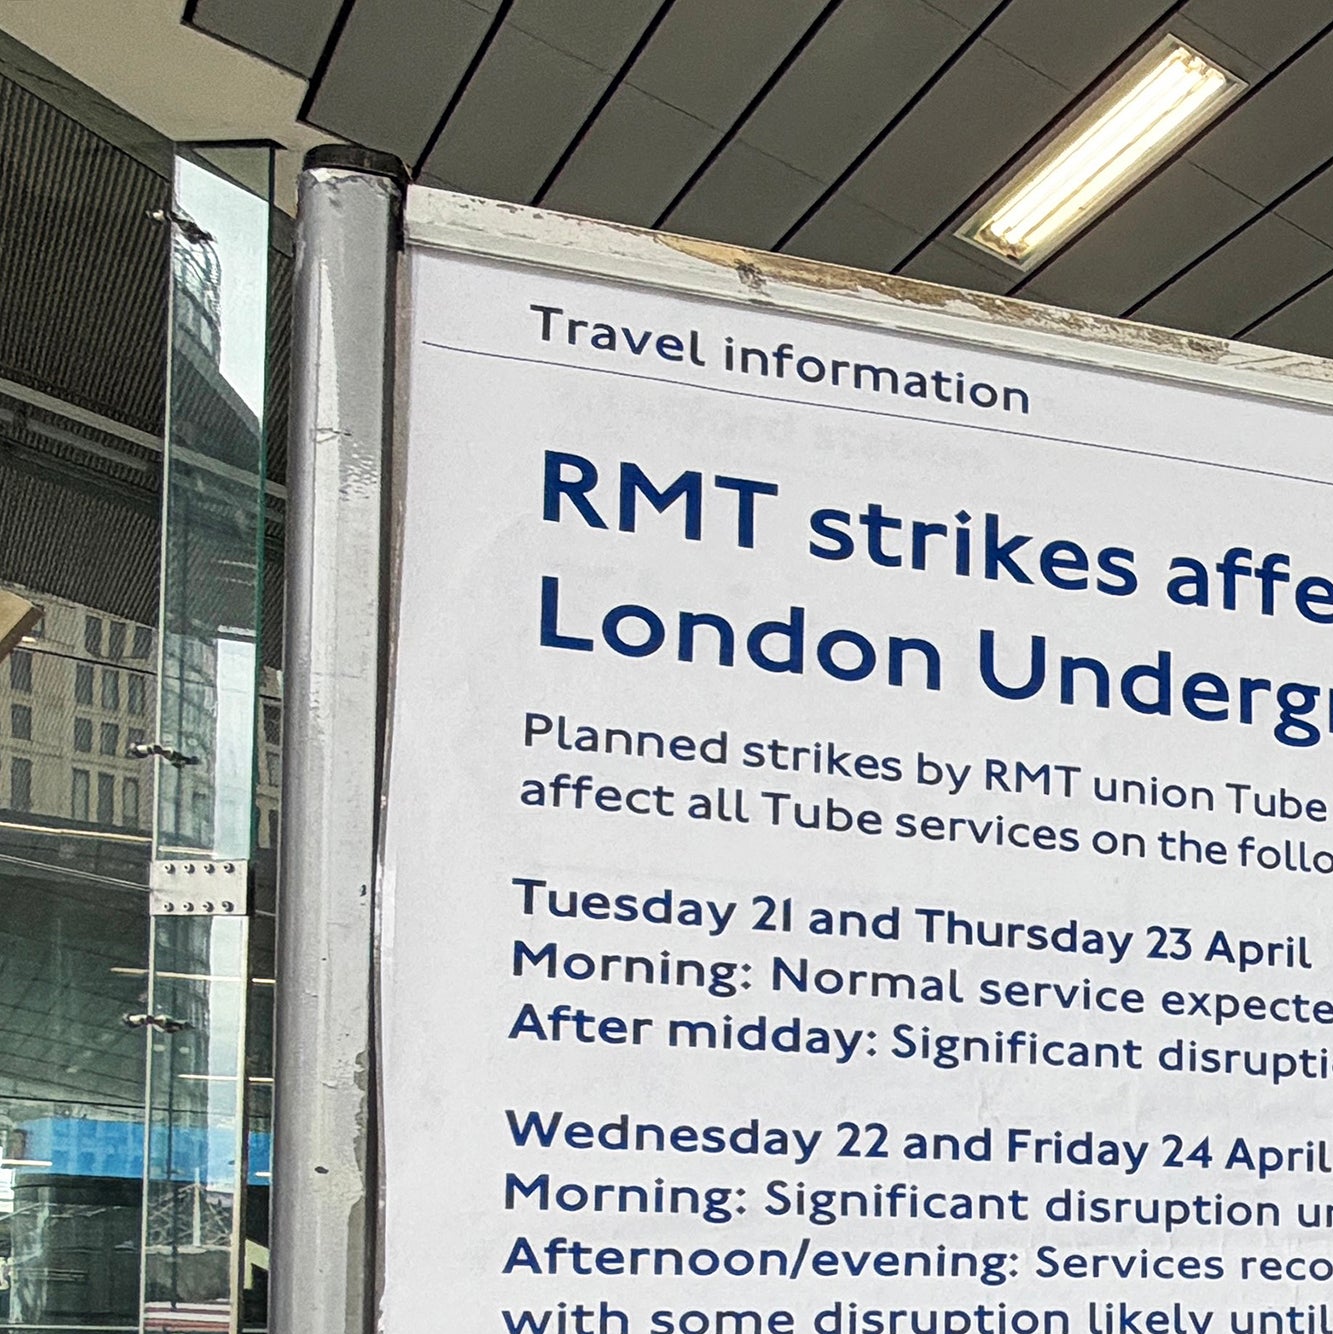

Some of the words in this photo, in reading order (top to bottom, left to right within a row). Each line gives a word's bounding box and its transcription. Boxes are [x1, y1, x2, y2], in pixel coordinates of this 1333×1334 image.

[530, 304, 705, 366] Travel
[725, 337, 1028, 414] information
[543, 450, 778, 549] RMT
[810, 503, 1137, 596] strikes
[540, 576, 940, 691] London
[525, 713, 727, 764] Planned
[743, 739, 902, 781] strikes
[917, 752, 971, 795] by
[986, 759, 1081, 797] RMT
[1094, 777, 1213, 811] union
[1225, 783, 1327, 822] Tube
[512, 878, 737, 936] Tuesday
[752, 895, 791, 932] 21
[809, 906, 899, 940] and
[915, 908, 1133, 964] Thursday
[1147, 926, 1192, 960] 23
[1204, 930, 1312, 972] April
[513, 940, 751, 997] Morning:
[773, 957, 963, 1003] Normal
[980, 978, 1144, 1013] service
[508, 1003, 653, 1045] After
[669, 1014, 876, 1064] midday:
[891, 1024, 1142, 1069] Significant
[505, 1110, 822, 1164] Wednesday
[837, 1122, 888, 1158] 22
[904, 1127, 991, 1161] and
[1008, 1129, 1149, 1175] Friday
[1162, 1134, 1212, 1168] 24
[1225, 1138, 1332, 1179] April
[505, 1173, 746, 1223] Morning:
[765, 1180, 1028, 1225] Significant
[1046, 1189, 1279, 1232] disruption
[502, 1237, 1018, 1286] Afternoon/evening:
[1036, 1246, 1224, 1279] Services
